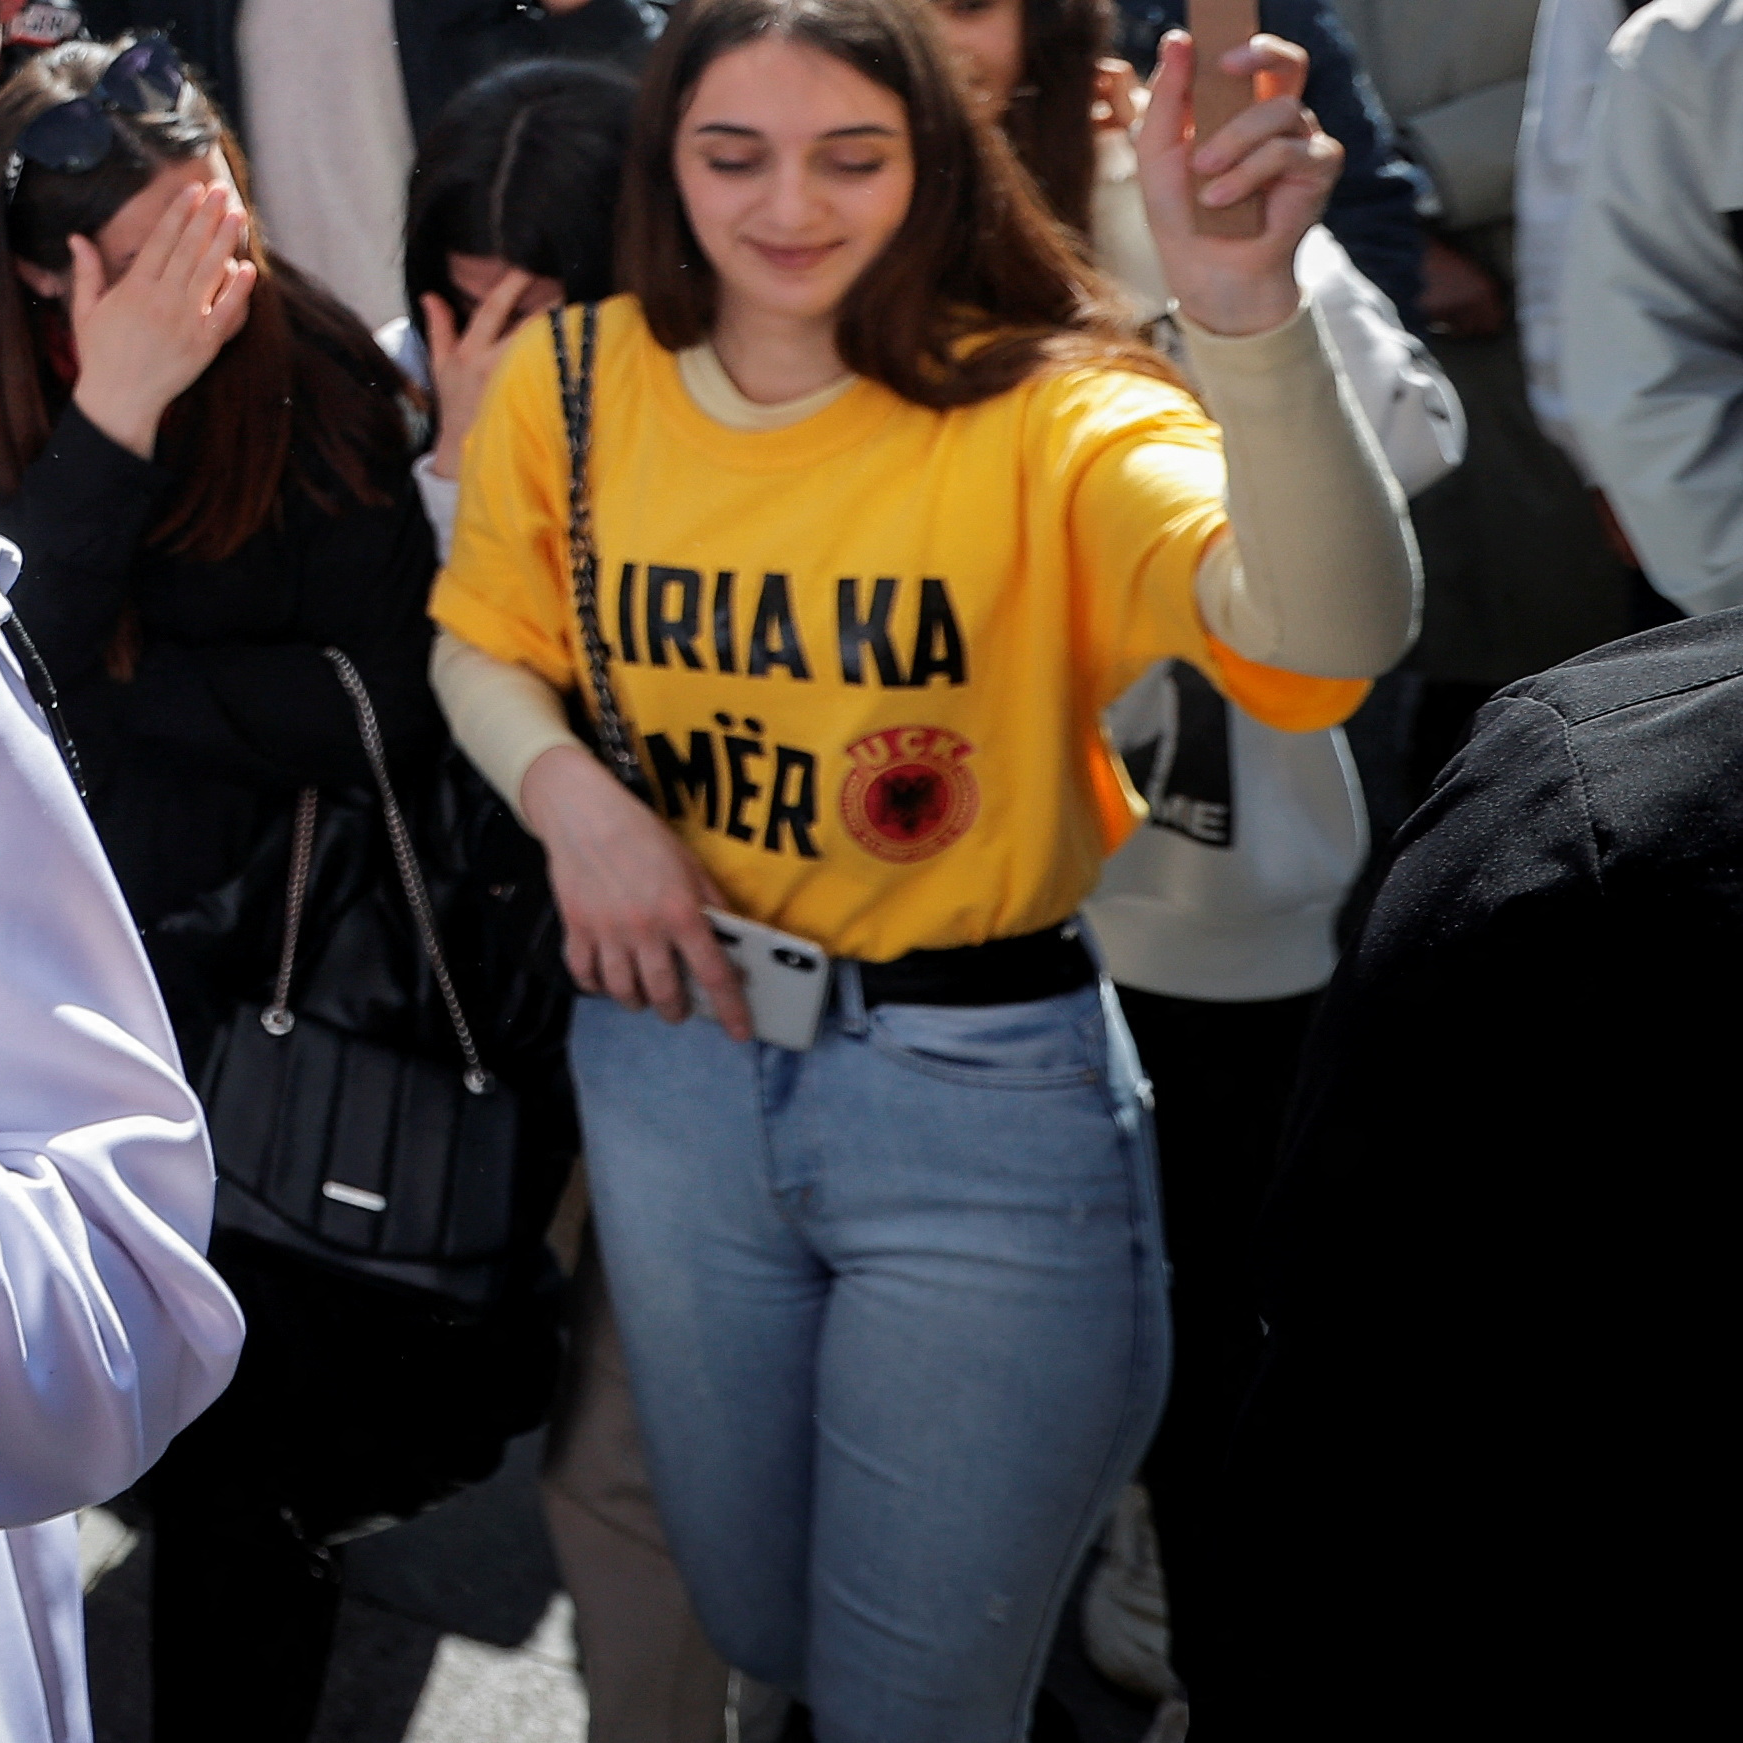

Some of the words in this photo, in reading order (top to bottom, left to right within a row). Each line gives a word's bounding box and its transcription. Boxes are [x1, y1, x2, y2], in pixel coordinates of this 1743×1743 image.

[593, 561, 812, 681] IRIA
[835, 577, 970, 688] KA
[643, 711, 822, 860] MËR
